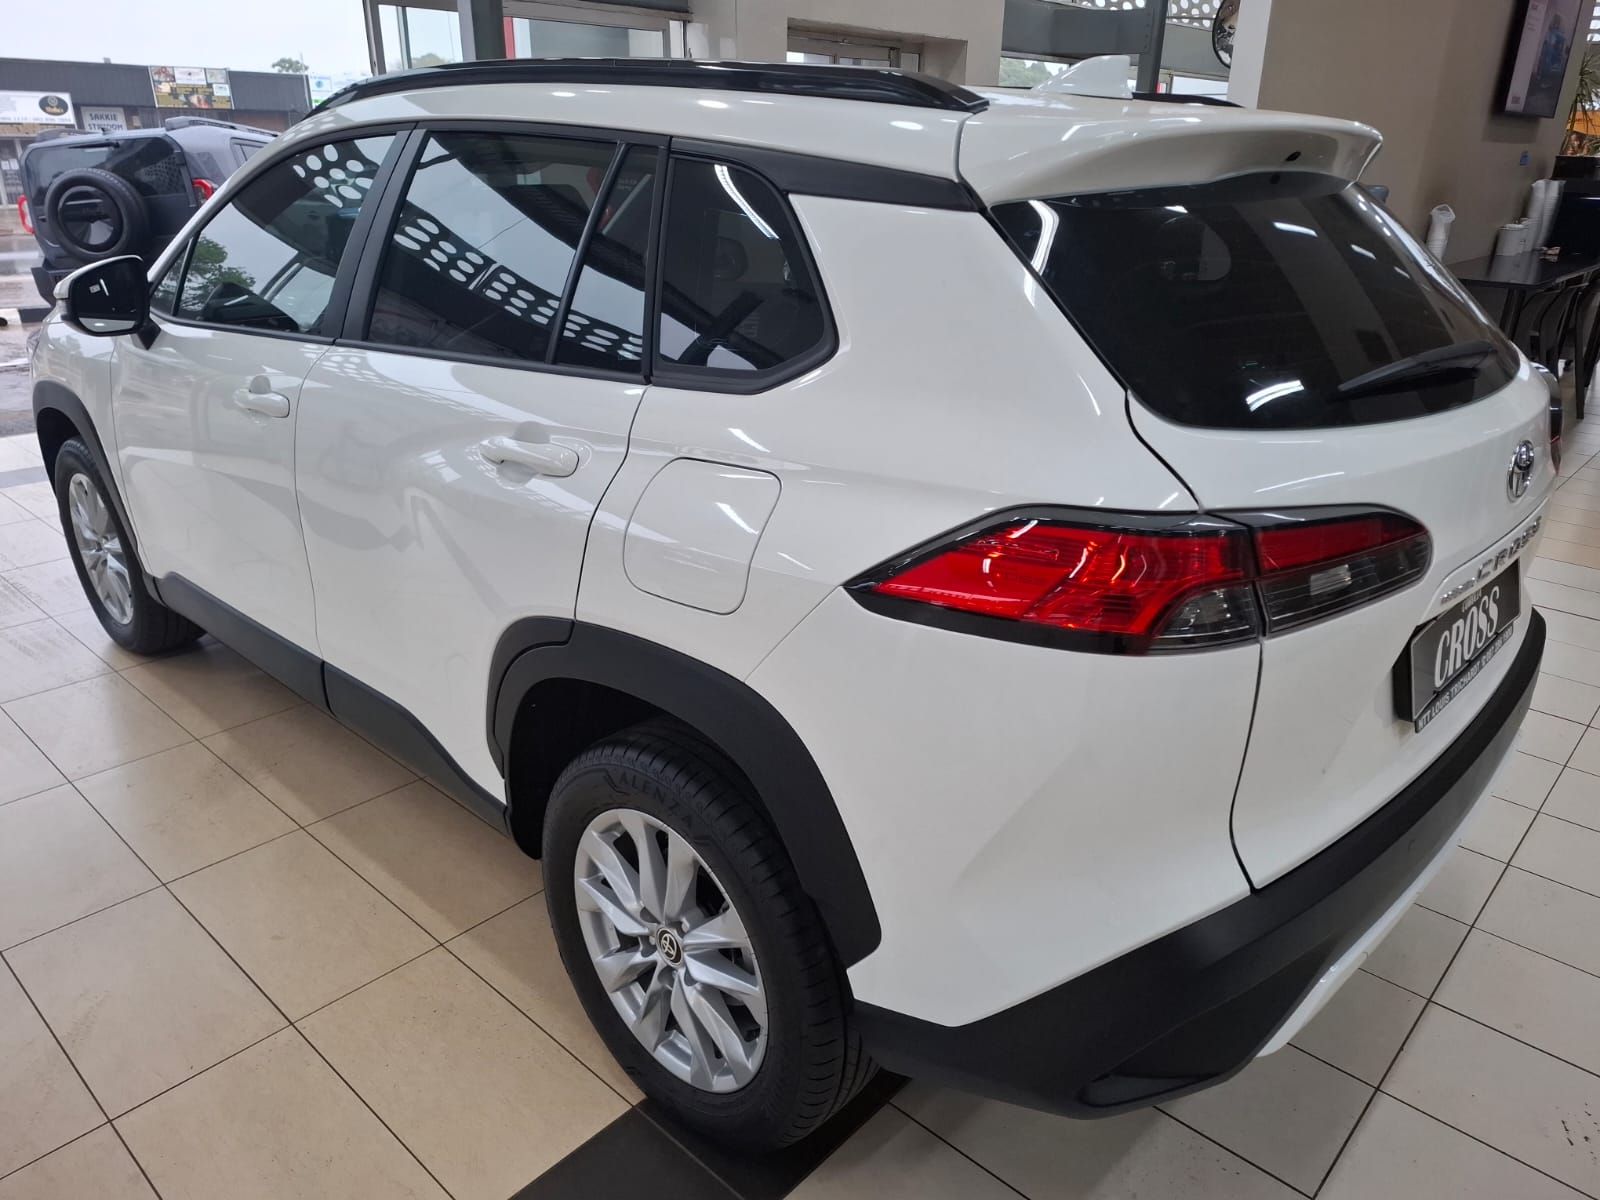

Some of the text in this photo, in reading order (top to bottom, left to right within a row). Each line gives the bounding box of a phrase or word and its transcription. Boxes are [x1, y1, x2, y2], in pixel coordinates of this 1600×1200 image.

[89, 112, 117, 121] SAKKIE
[1434, 585, 1500, 688] CROSS
[1432, 691, 1450, 717] LOUIS
[617, 771, 695, 831] ALENZA
